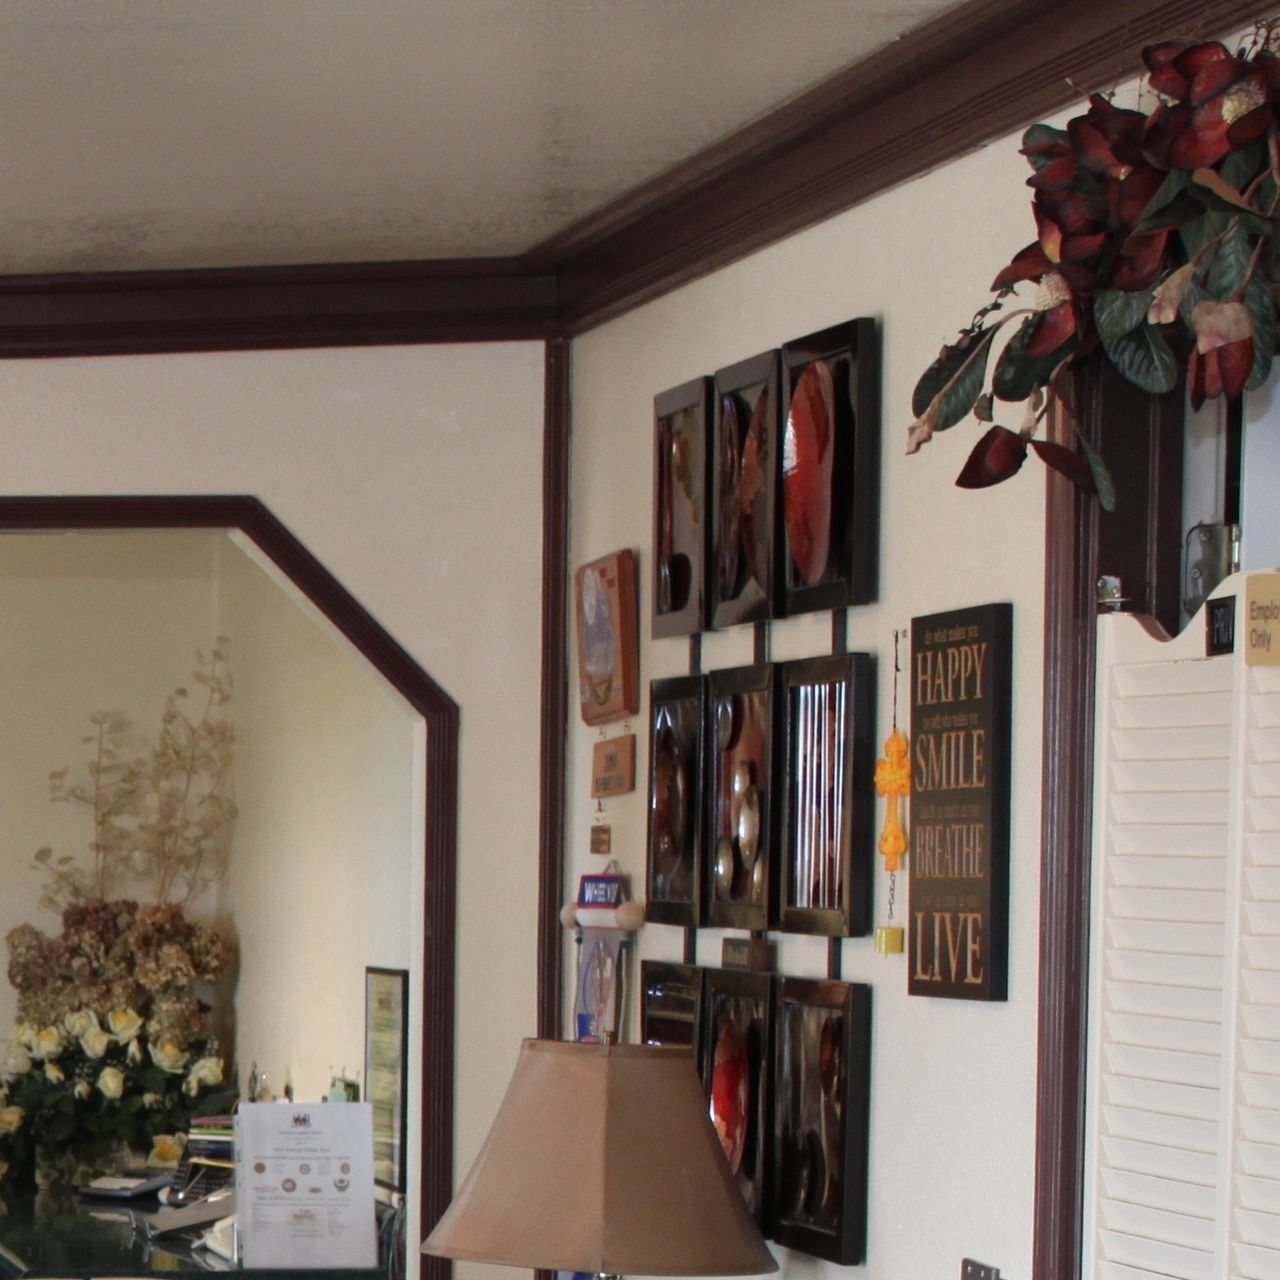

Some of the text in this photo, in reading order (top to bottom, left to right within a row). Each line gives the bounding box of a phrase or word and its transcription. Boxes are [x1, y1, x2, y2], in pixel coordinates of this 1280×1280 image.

[1250, 628, 1272, 653] Only
[915, 642, 988, 706] HAPPY
[915, 729, 986, 792] SMILE
[915, 824, 985, 879] BREATHE
[914, 911, 984, 985] LIVE
